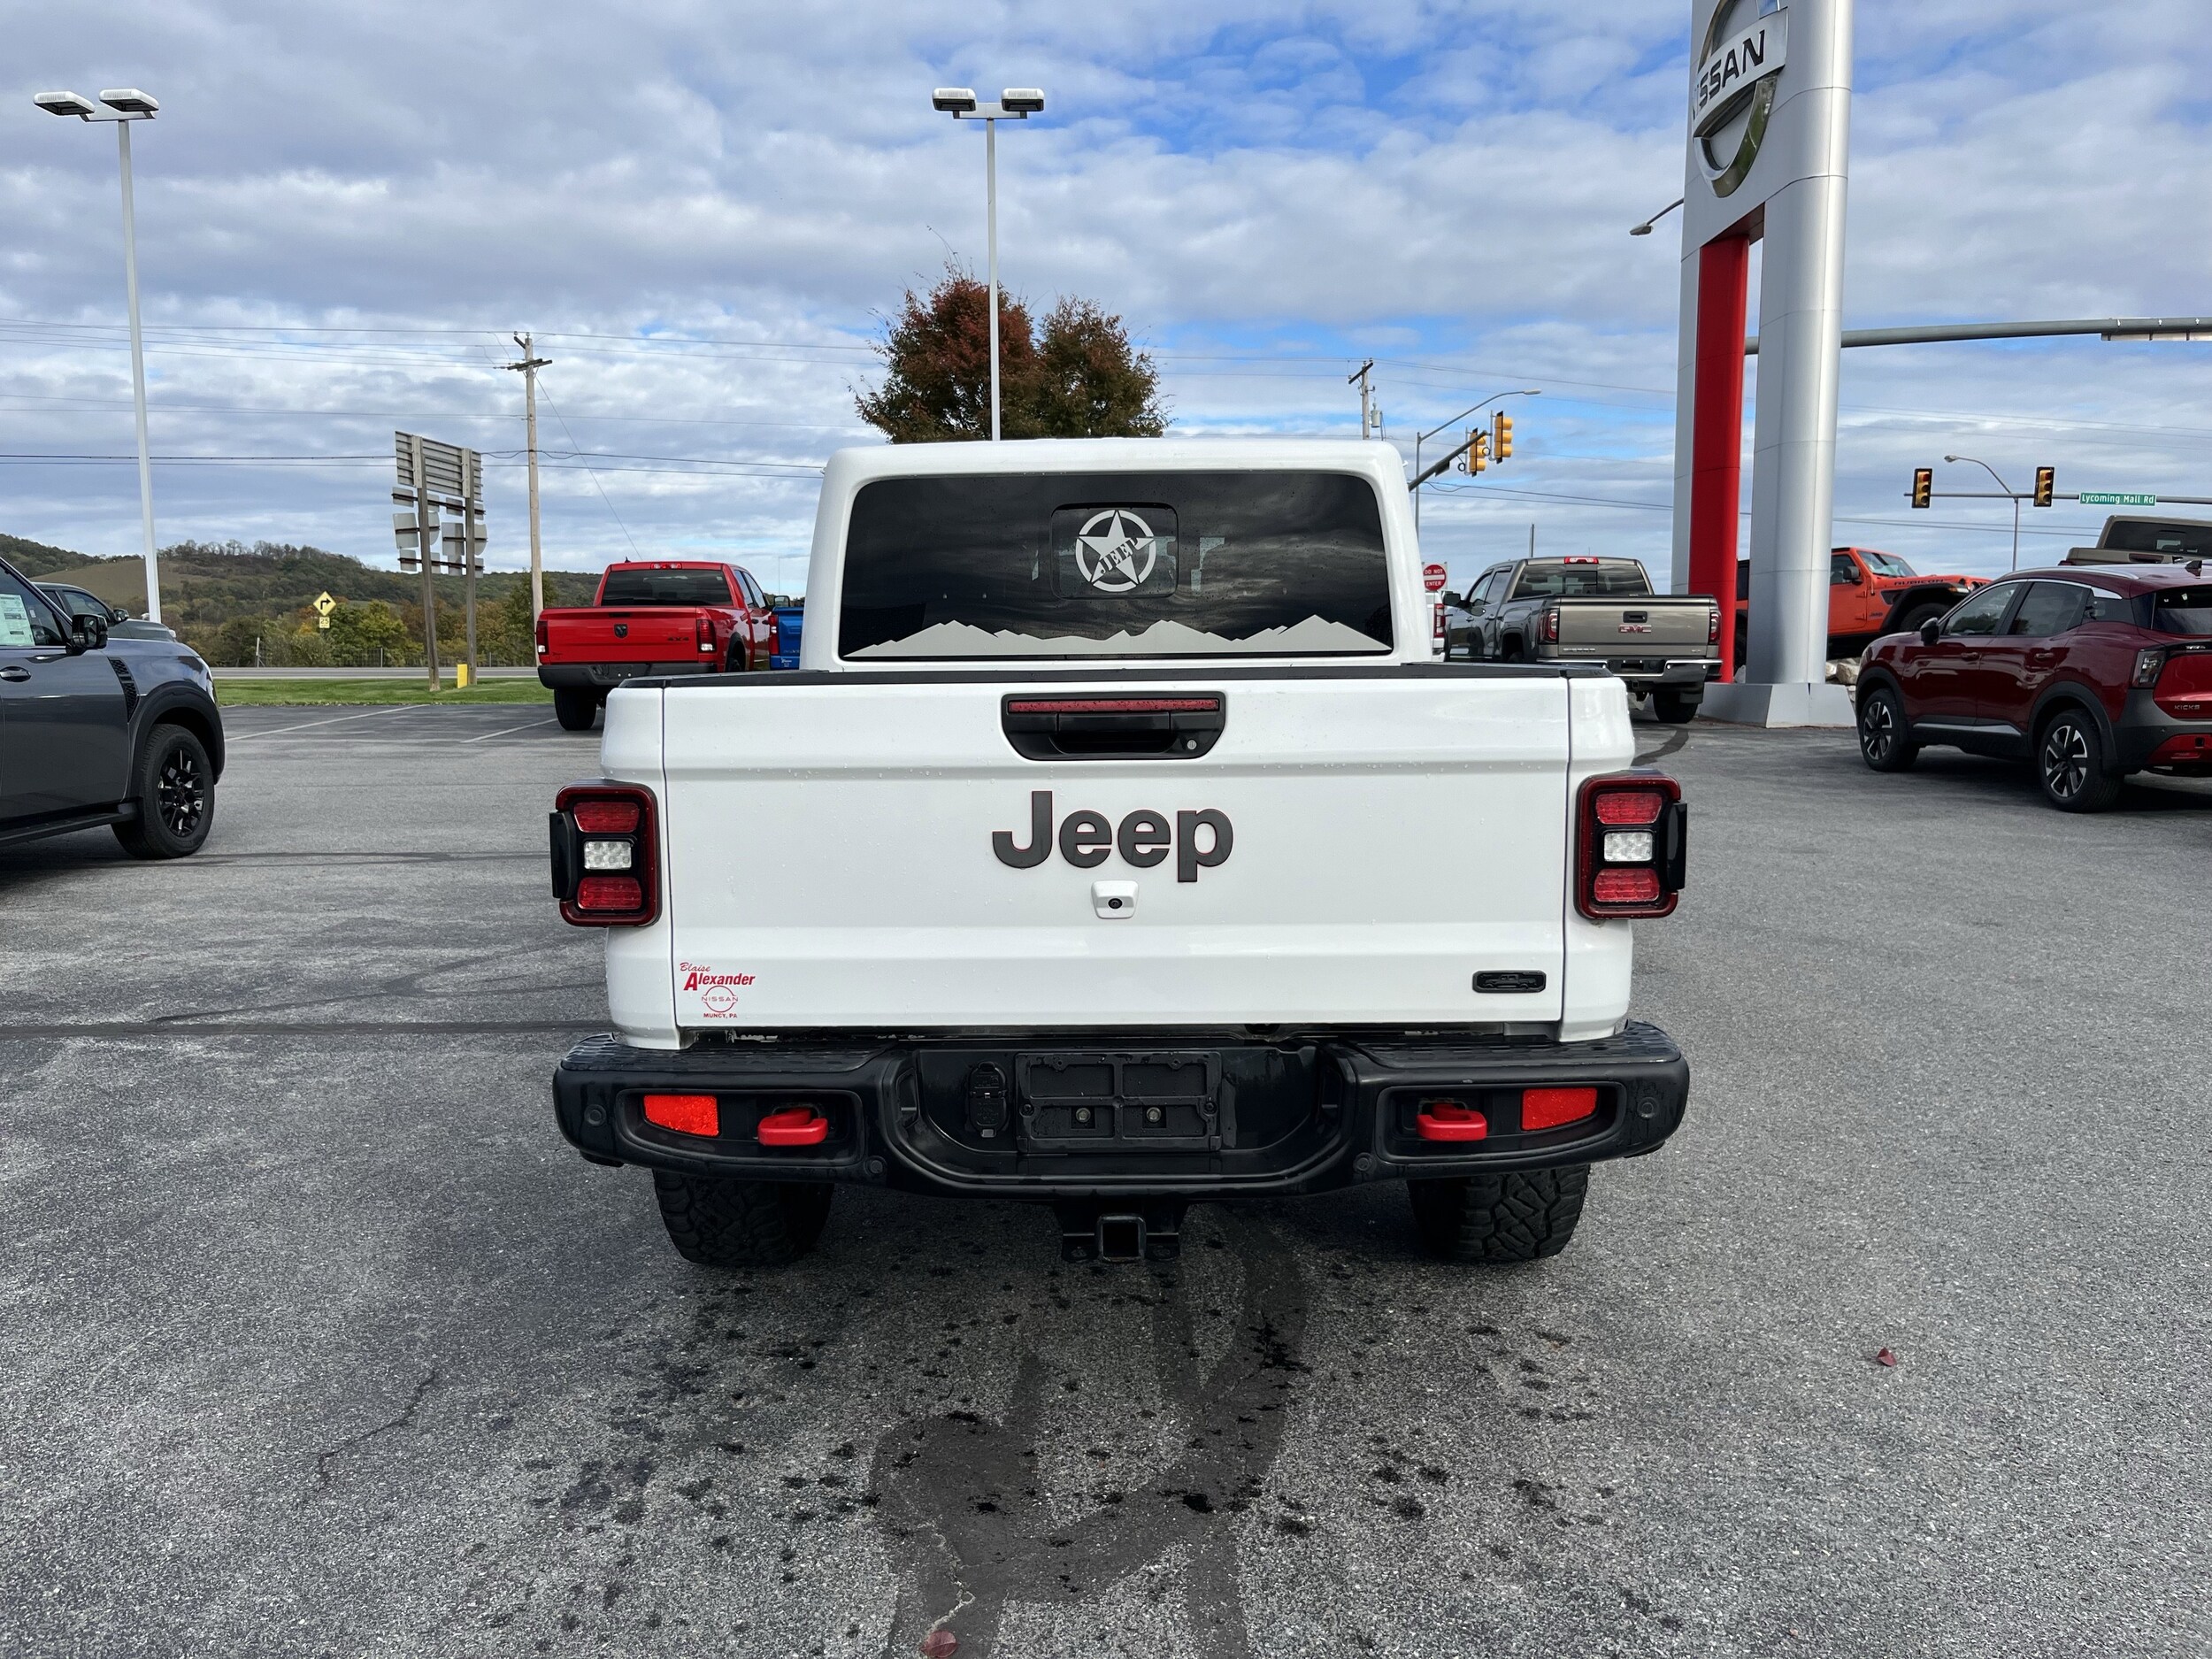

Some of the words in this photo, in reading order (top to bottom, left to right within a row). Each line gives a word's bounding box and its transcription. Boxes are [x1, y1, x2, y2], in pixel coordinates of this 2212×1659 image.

[2082, 494, 2120, 505] Lycoming
[2124, 495, 2140, 503] Mall
[1098, 538, 1139, 574] JEEP
[1618, 624, 1652, 634] GMC
[992, 790, 1233, 883] Jeep
[680, 962, 710, 972] Blaise
[683, 972, 756, 990] Alexander
